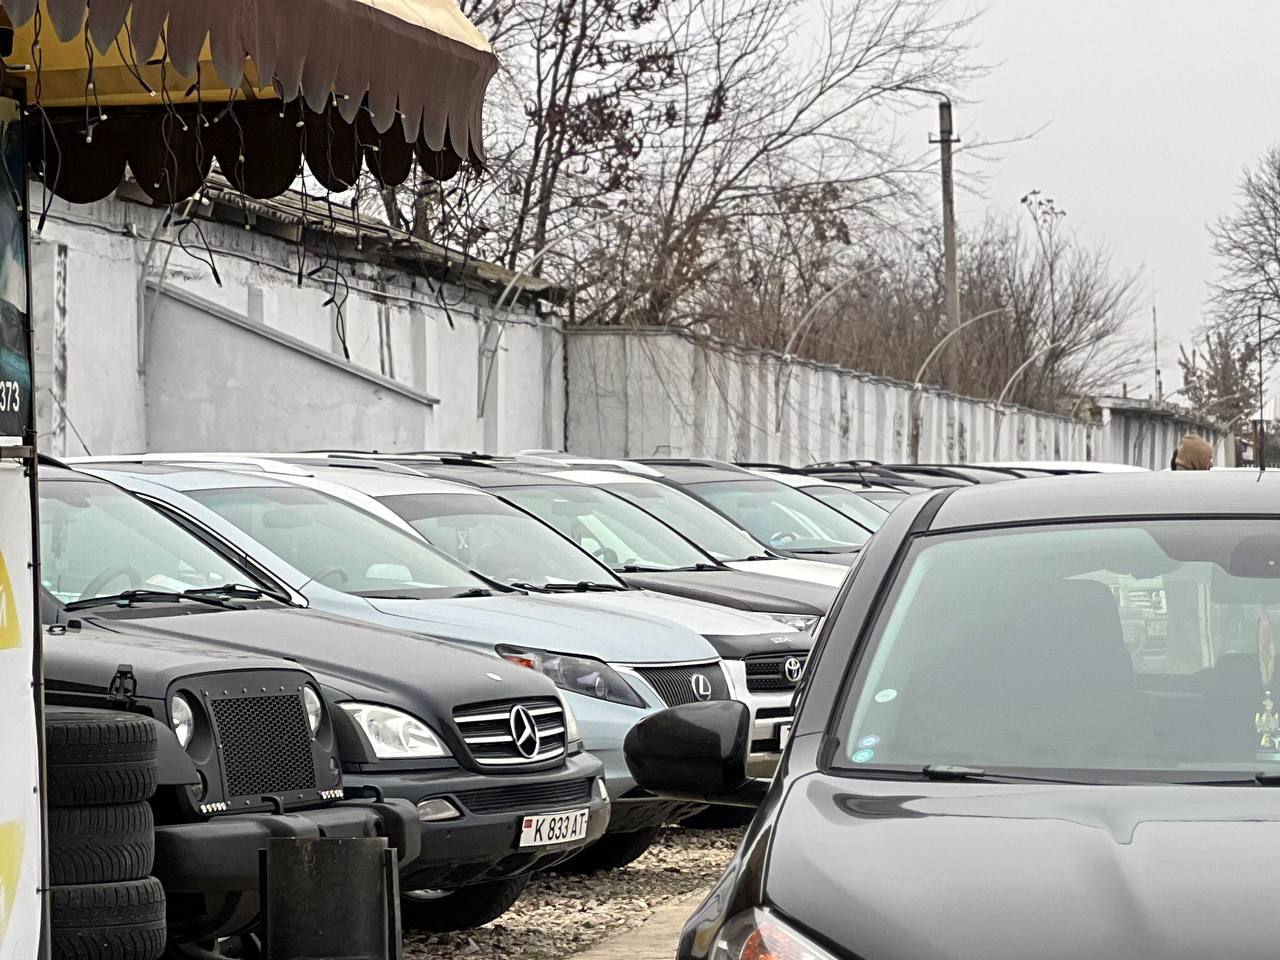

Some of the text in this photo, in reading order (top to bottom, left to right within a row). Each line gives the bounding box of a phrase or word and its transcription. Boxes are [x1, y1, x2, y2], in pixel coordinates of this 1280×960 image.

[534, 813, 586, 842] K 833 AT
